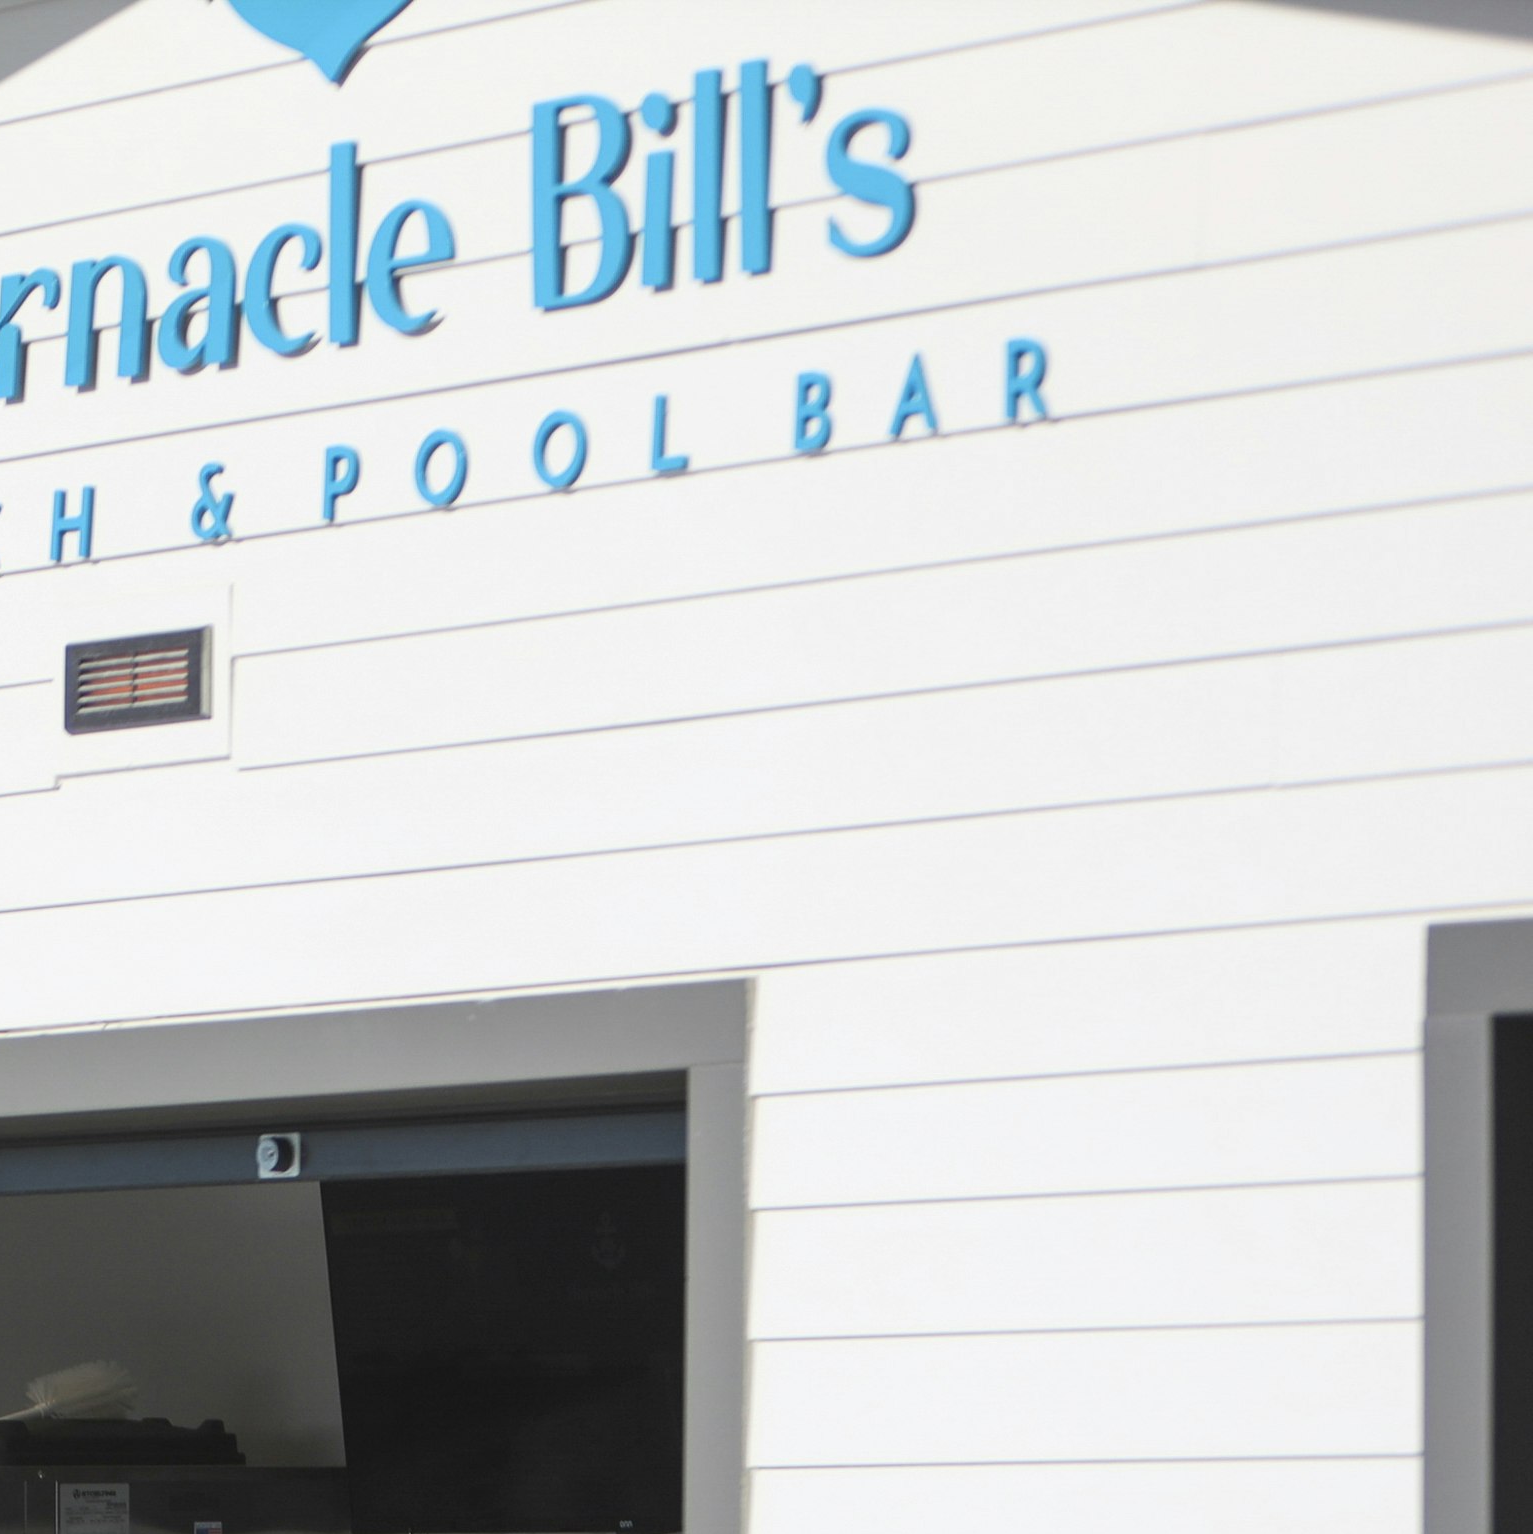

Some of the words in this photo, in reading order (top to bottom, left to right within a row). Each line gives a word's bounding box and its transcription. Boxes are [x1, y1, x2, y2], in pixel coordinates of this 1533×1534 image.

[530, 58, 914, 312] Bill's
[191, 462, 234, 541] &
[322, 394, 689, 522] POOL
[794, 337, 1049, 453] BAR
